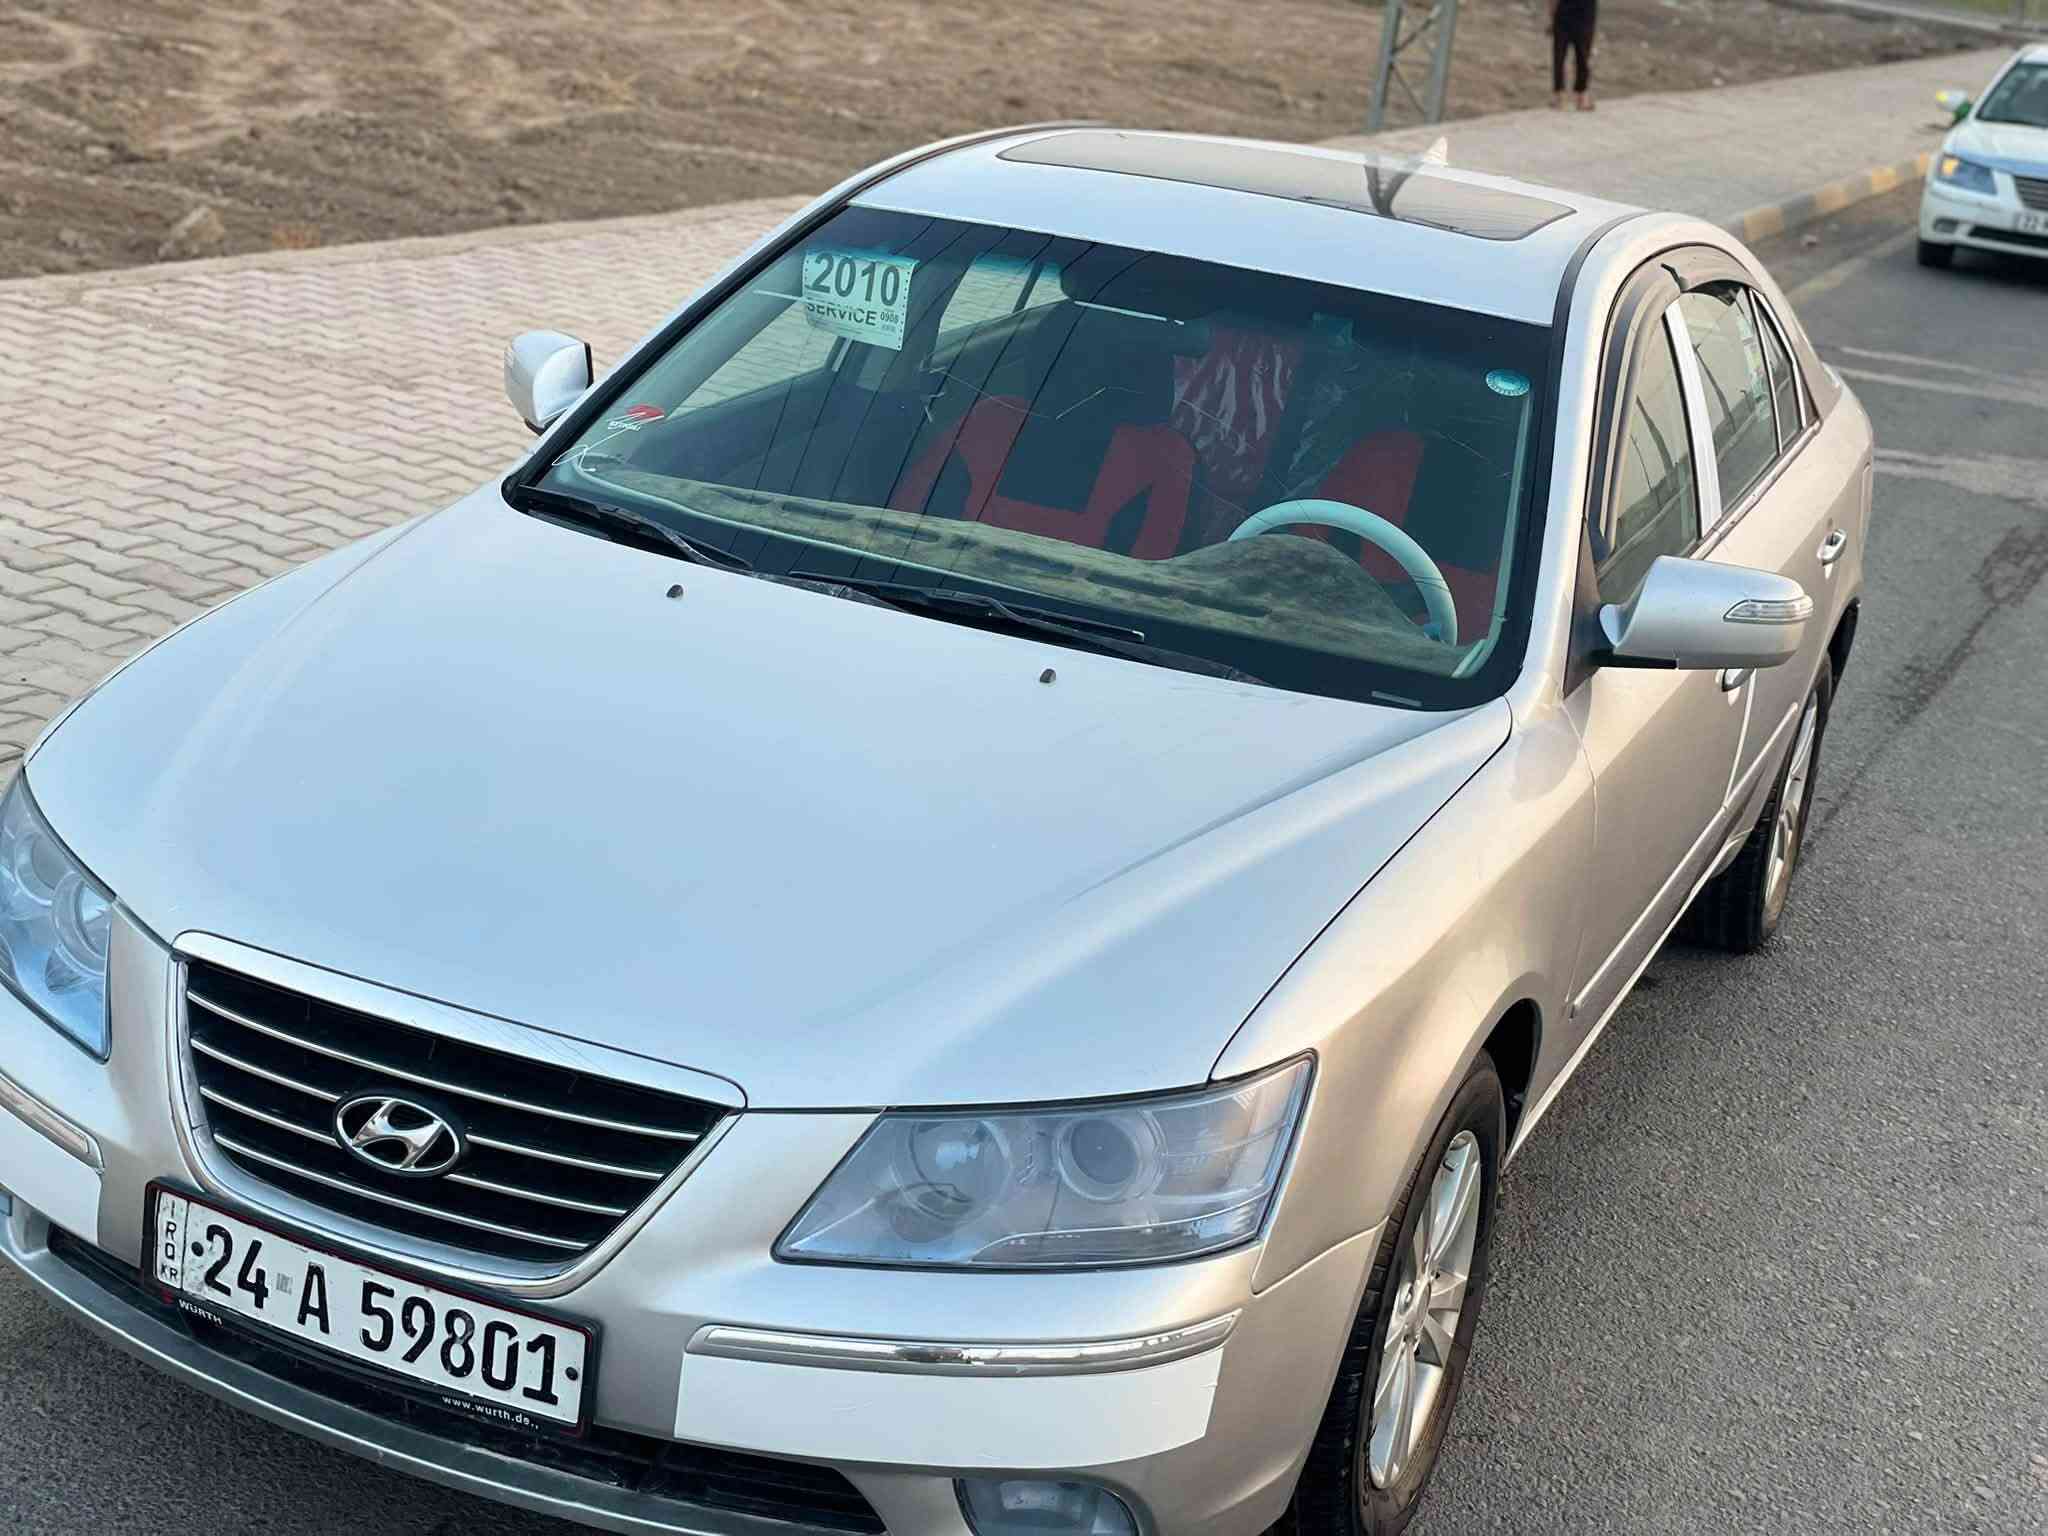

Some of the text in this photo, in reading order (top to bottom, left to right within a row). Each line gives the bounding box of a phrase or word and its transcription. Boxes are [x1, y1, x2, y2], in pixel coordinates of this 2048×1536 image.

[804, 252, 900, 306] 2010
[807, 303, 878, 326] SERVICE
[204, 1224, 559, 1406] 24 A 59801
